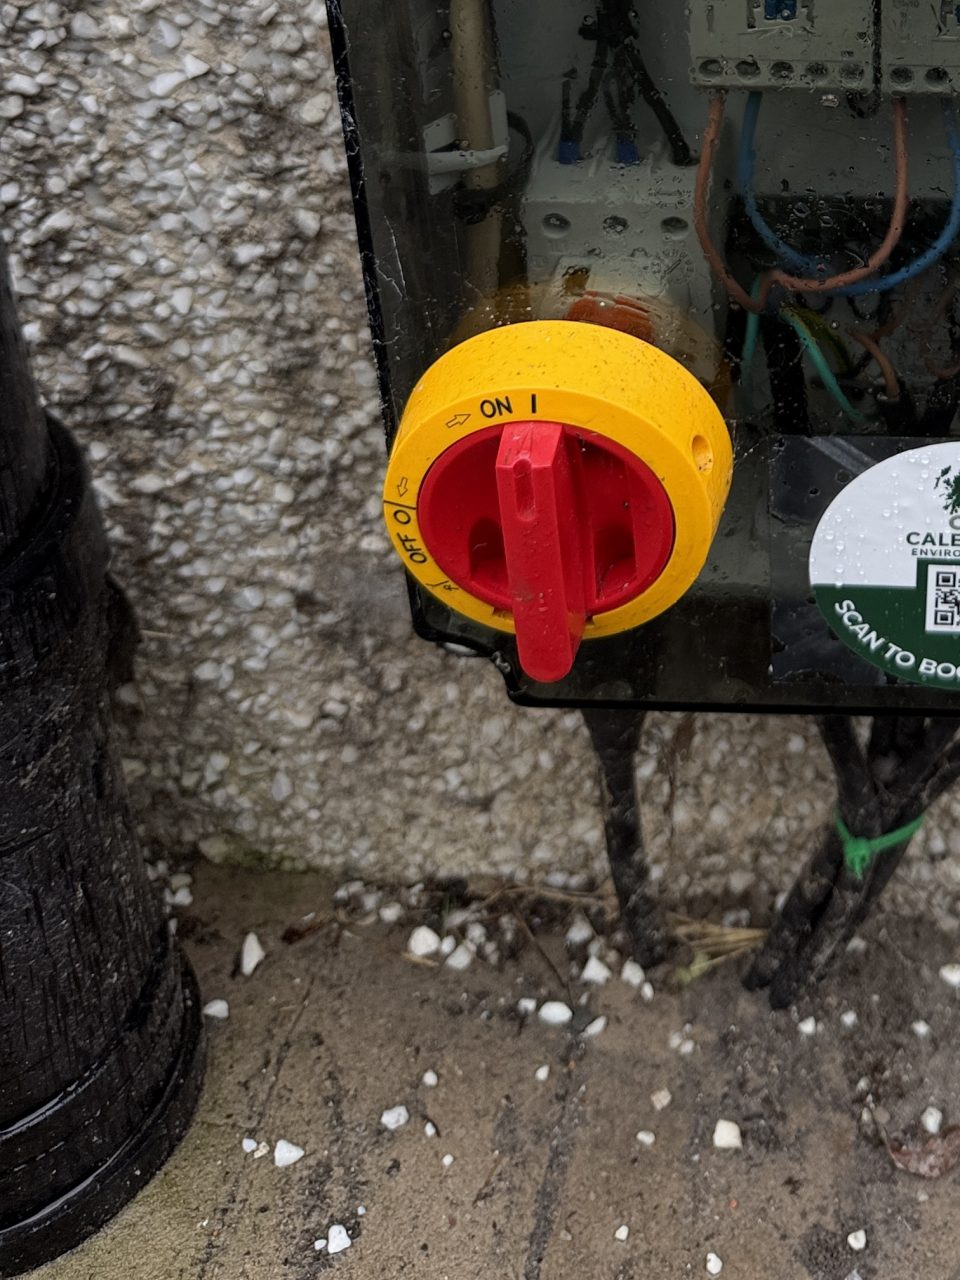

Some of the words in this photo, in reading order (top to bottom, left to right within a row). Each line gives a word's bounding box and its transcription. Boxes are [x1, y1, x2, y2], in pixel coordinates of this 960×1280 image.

[479, 396, 514, 419] ON
[397, 532, 427, 564] OFF
[835, 599, 885, 650] SCAN
[885, 642, 916, 668] TO
